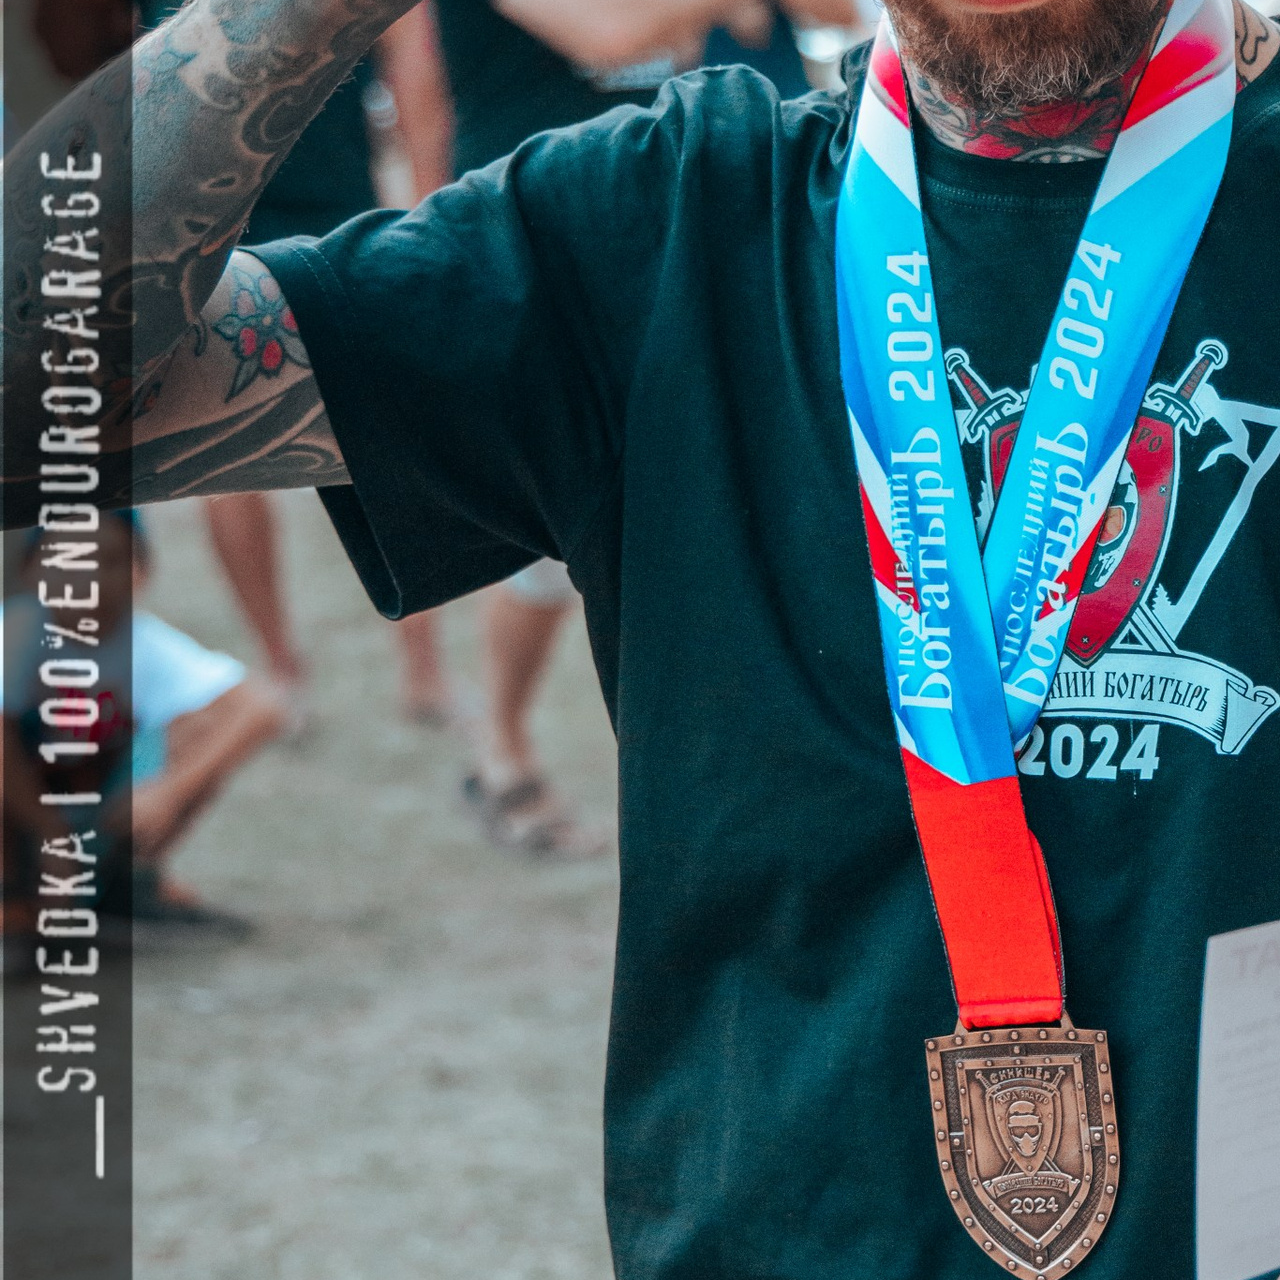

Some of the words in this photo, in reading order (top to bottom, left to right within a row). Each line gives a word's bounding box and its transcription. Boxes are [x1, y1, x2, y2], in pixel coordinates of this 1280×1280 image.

[886, 250, 936, 402] 2024
[1048, 239, 1122, 400] 2024
[1018, 723, 1160, 781] 2024
[1010, 1196, 1059, 1215] 2024
